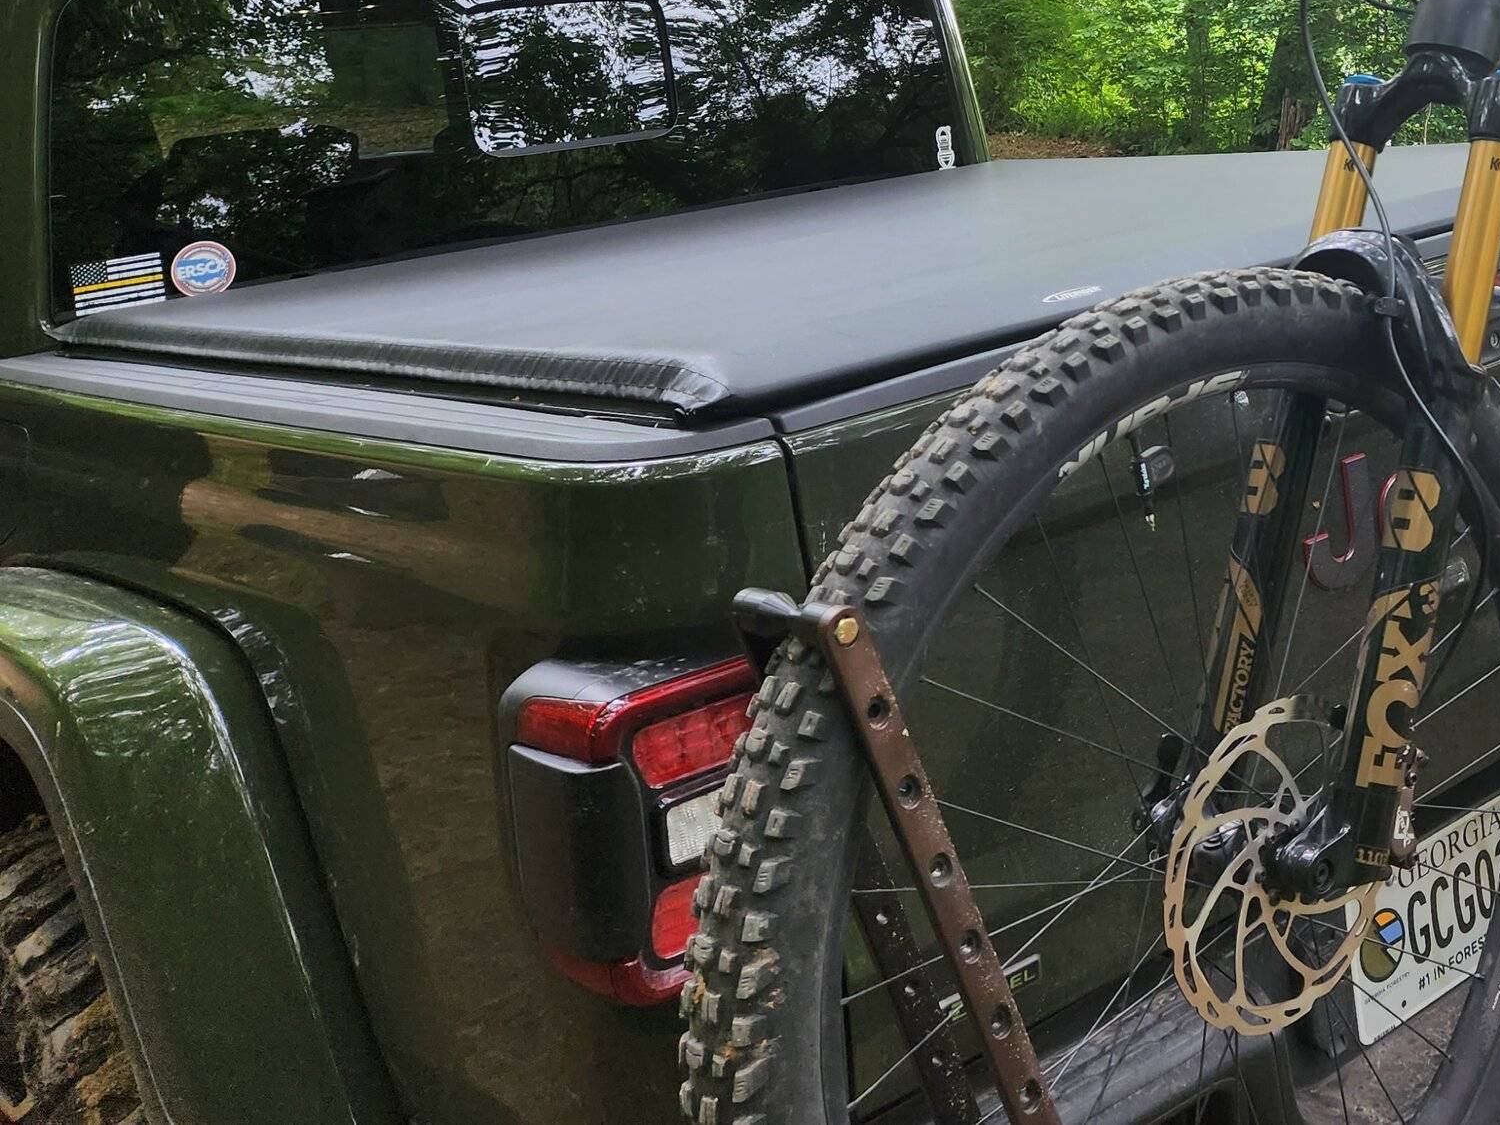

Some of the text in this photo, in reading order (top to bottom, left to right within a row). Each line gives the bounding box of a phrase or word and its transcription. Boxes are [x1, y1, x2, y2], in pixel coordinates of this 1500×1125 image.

[1355, 621, 1434, 789] FOX
[1418, 972, 1431, 991] #1
[1434, 963, 1447, 981] IN
